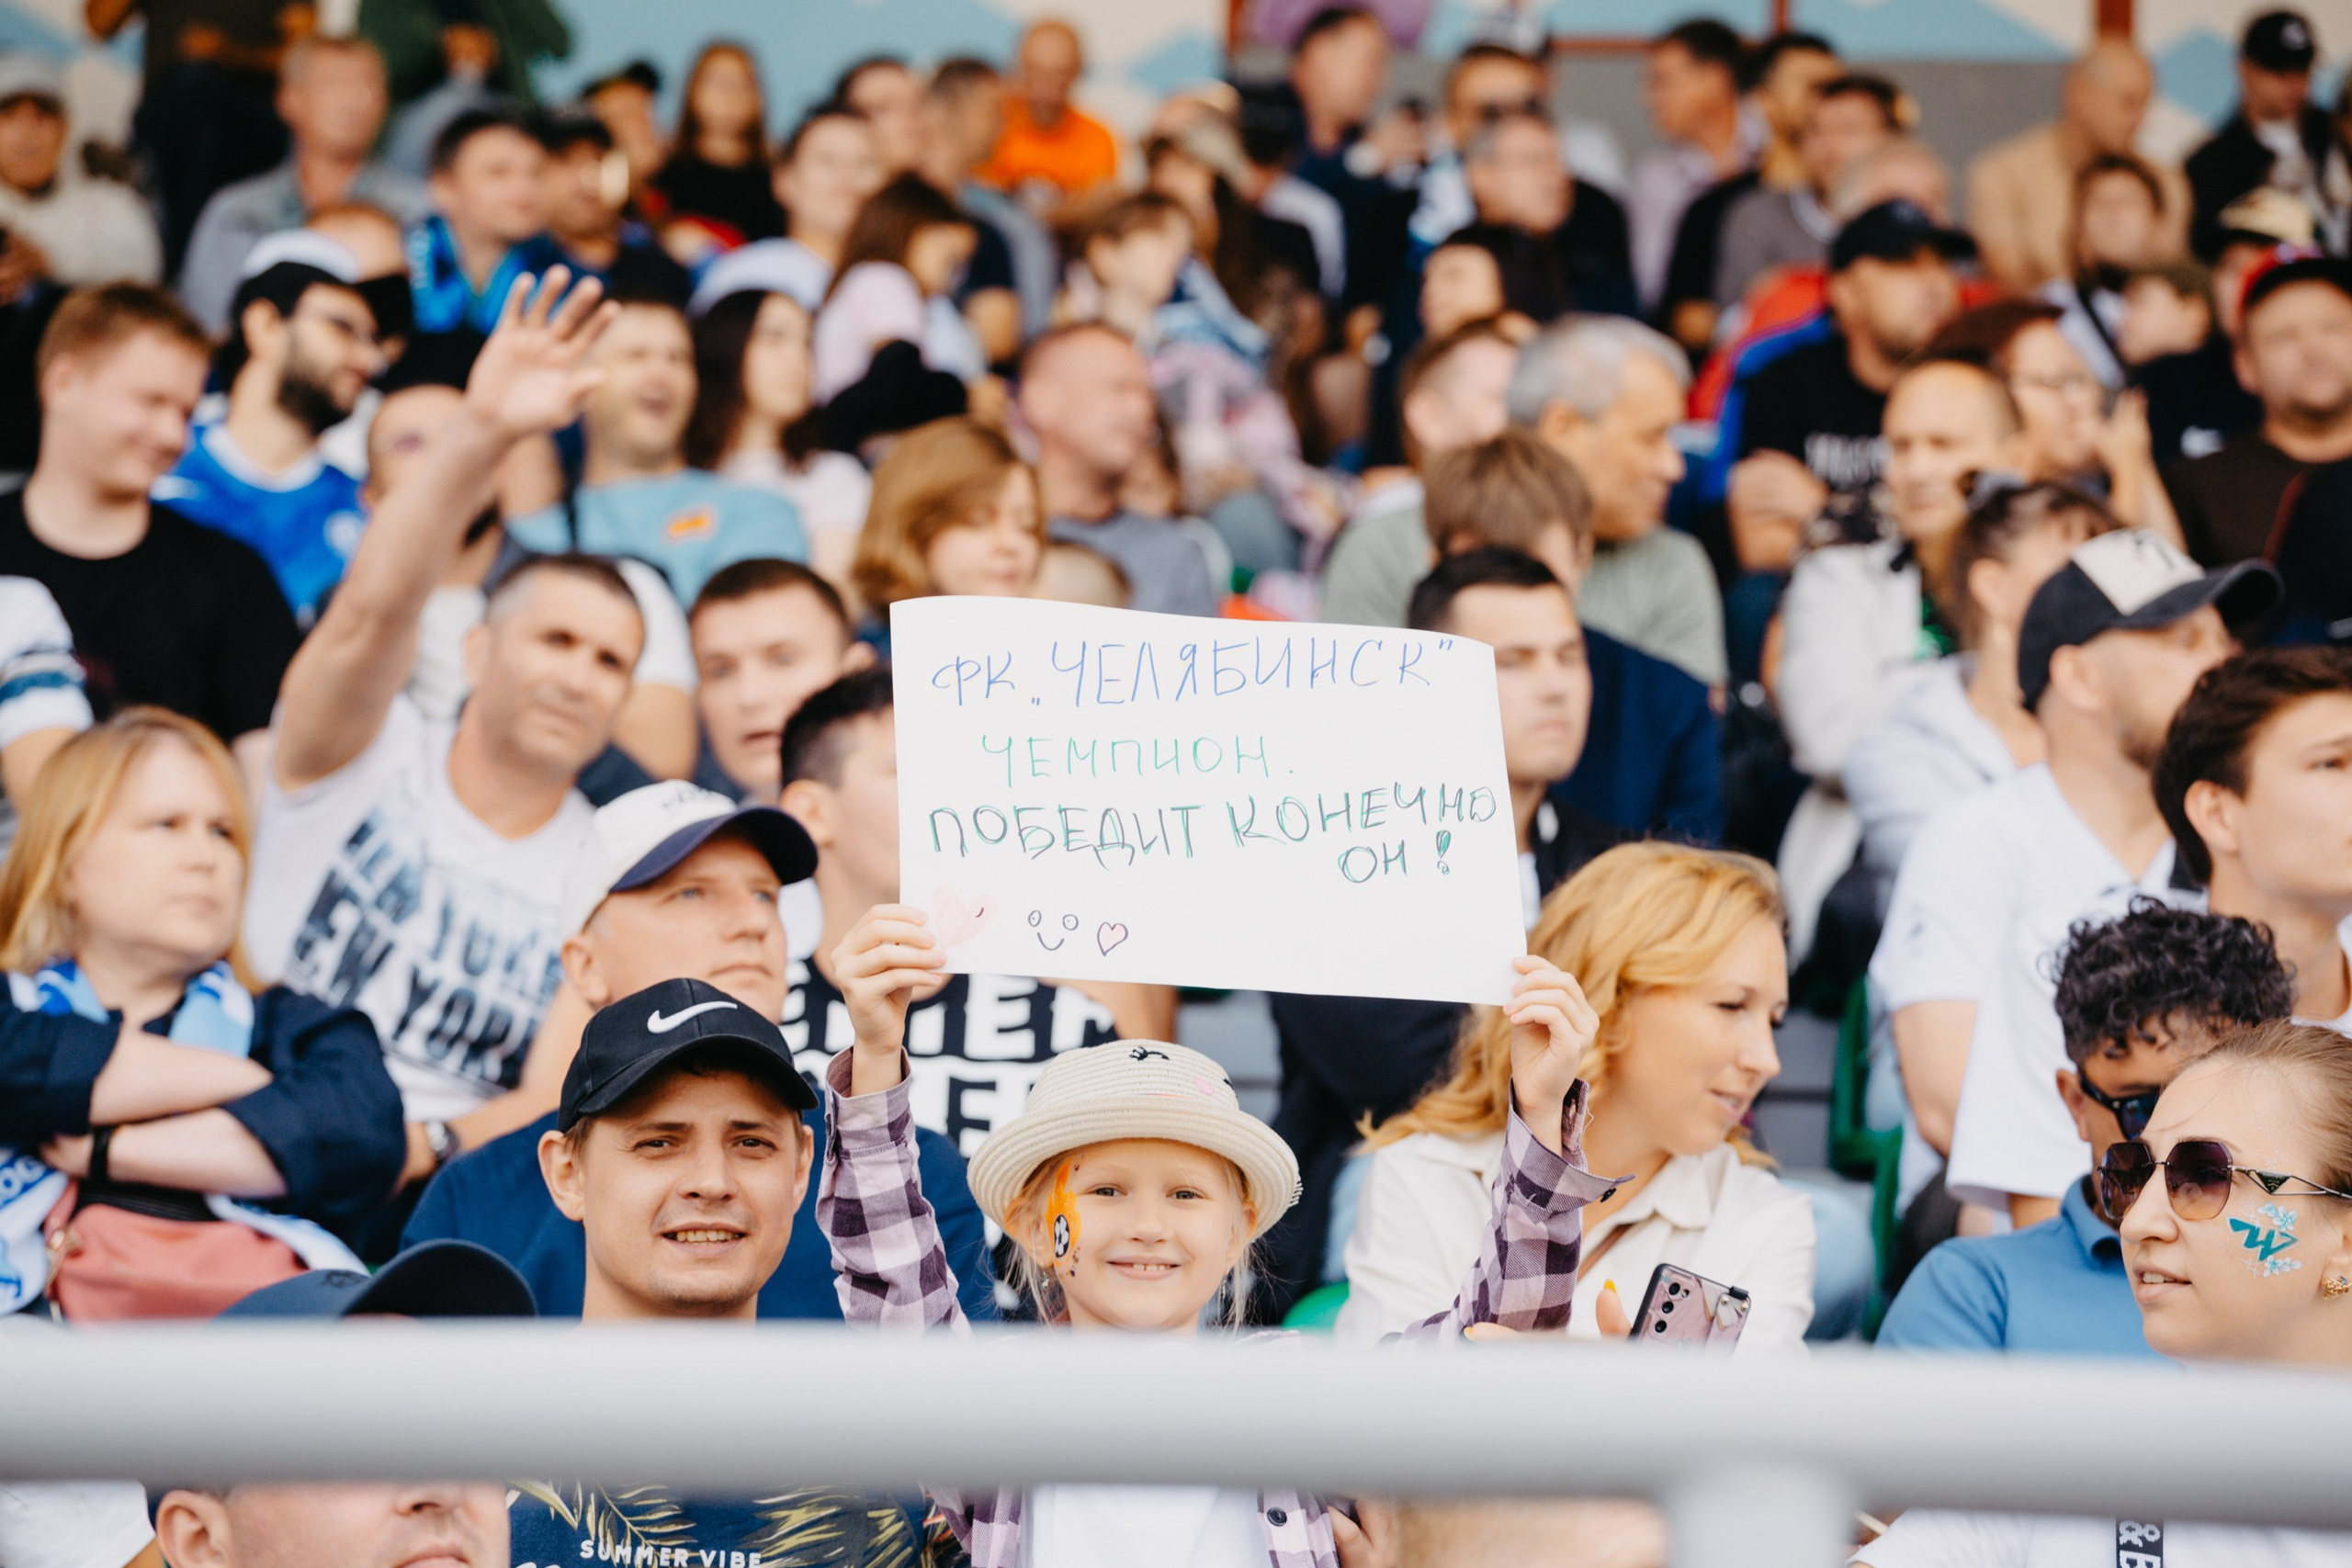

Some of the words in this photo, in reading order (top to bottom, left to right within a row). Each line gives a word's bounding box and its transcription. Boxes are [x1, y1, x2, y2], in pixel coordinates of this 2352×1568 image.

[932, 651, 1015, 705] ФК
[982, 734, 1294, 789] ЧЕМПИОН.
[929, 804, 1204, 869] ПОБЕДИТ
[1226, 782, 1497, 847] КОНЕЧНО
[580, 1540, 689, 1567] SUMMER
[699, 1549, 762, 1568] VIBE
